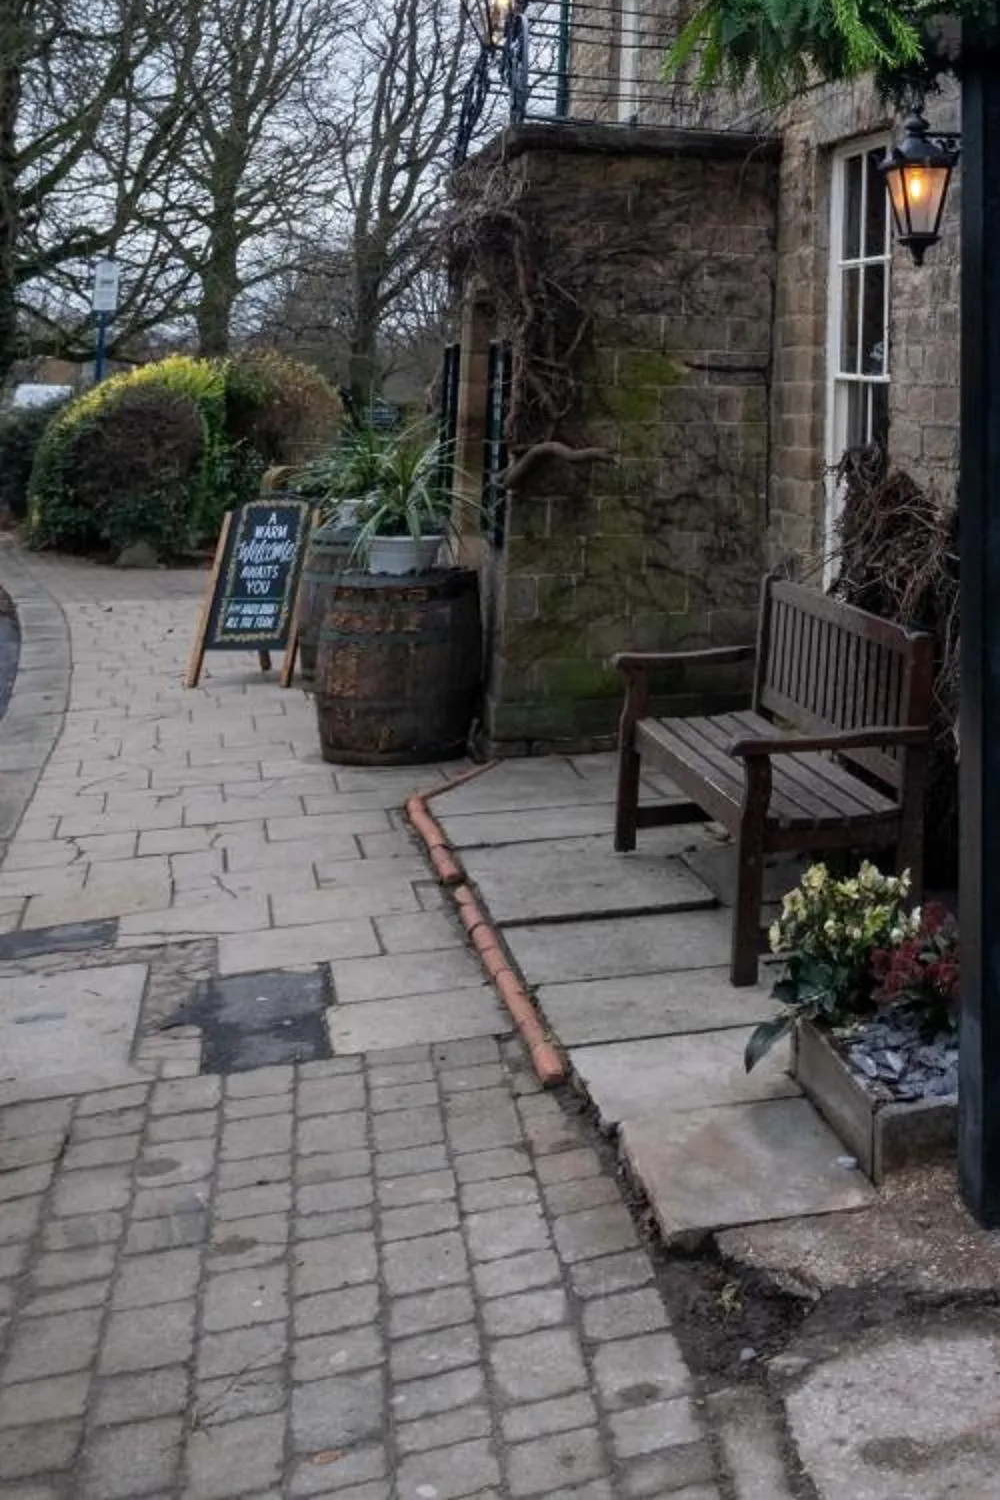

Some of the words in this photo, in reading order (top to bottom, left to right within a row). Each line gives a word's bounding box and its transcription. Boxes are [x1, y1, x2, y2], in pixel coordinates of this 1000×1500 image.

[268, 511, 277, 525] A
[255, 524, 289, 539] WARM
[246, 579, 271, 595] YOU
